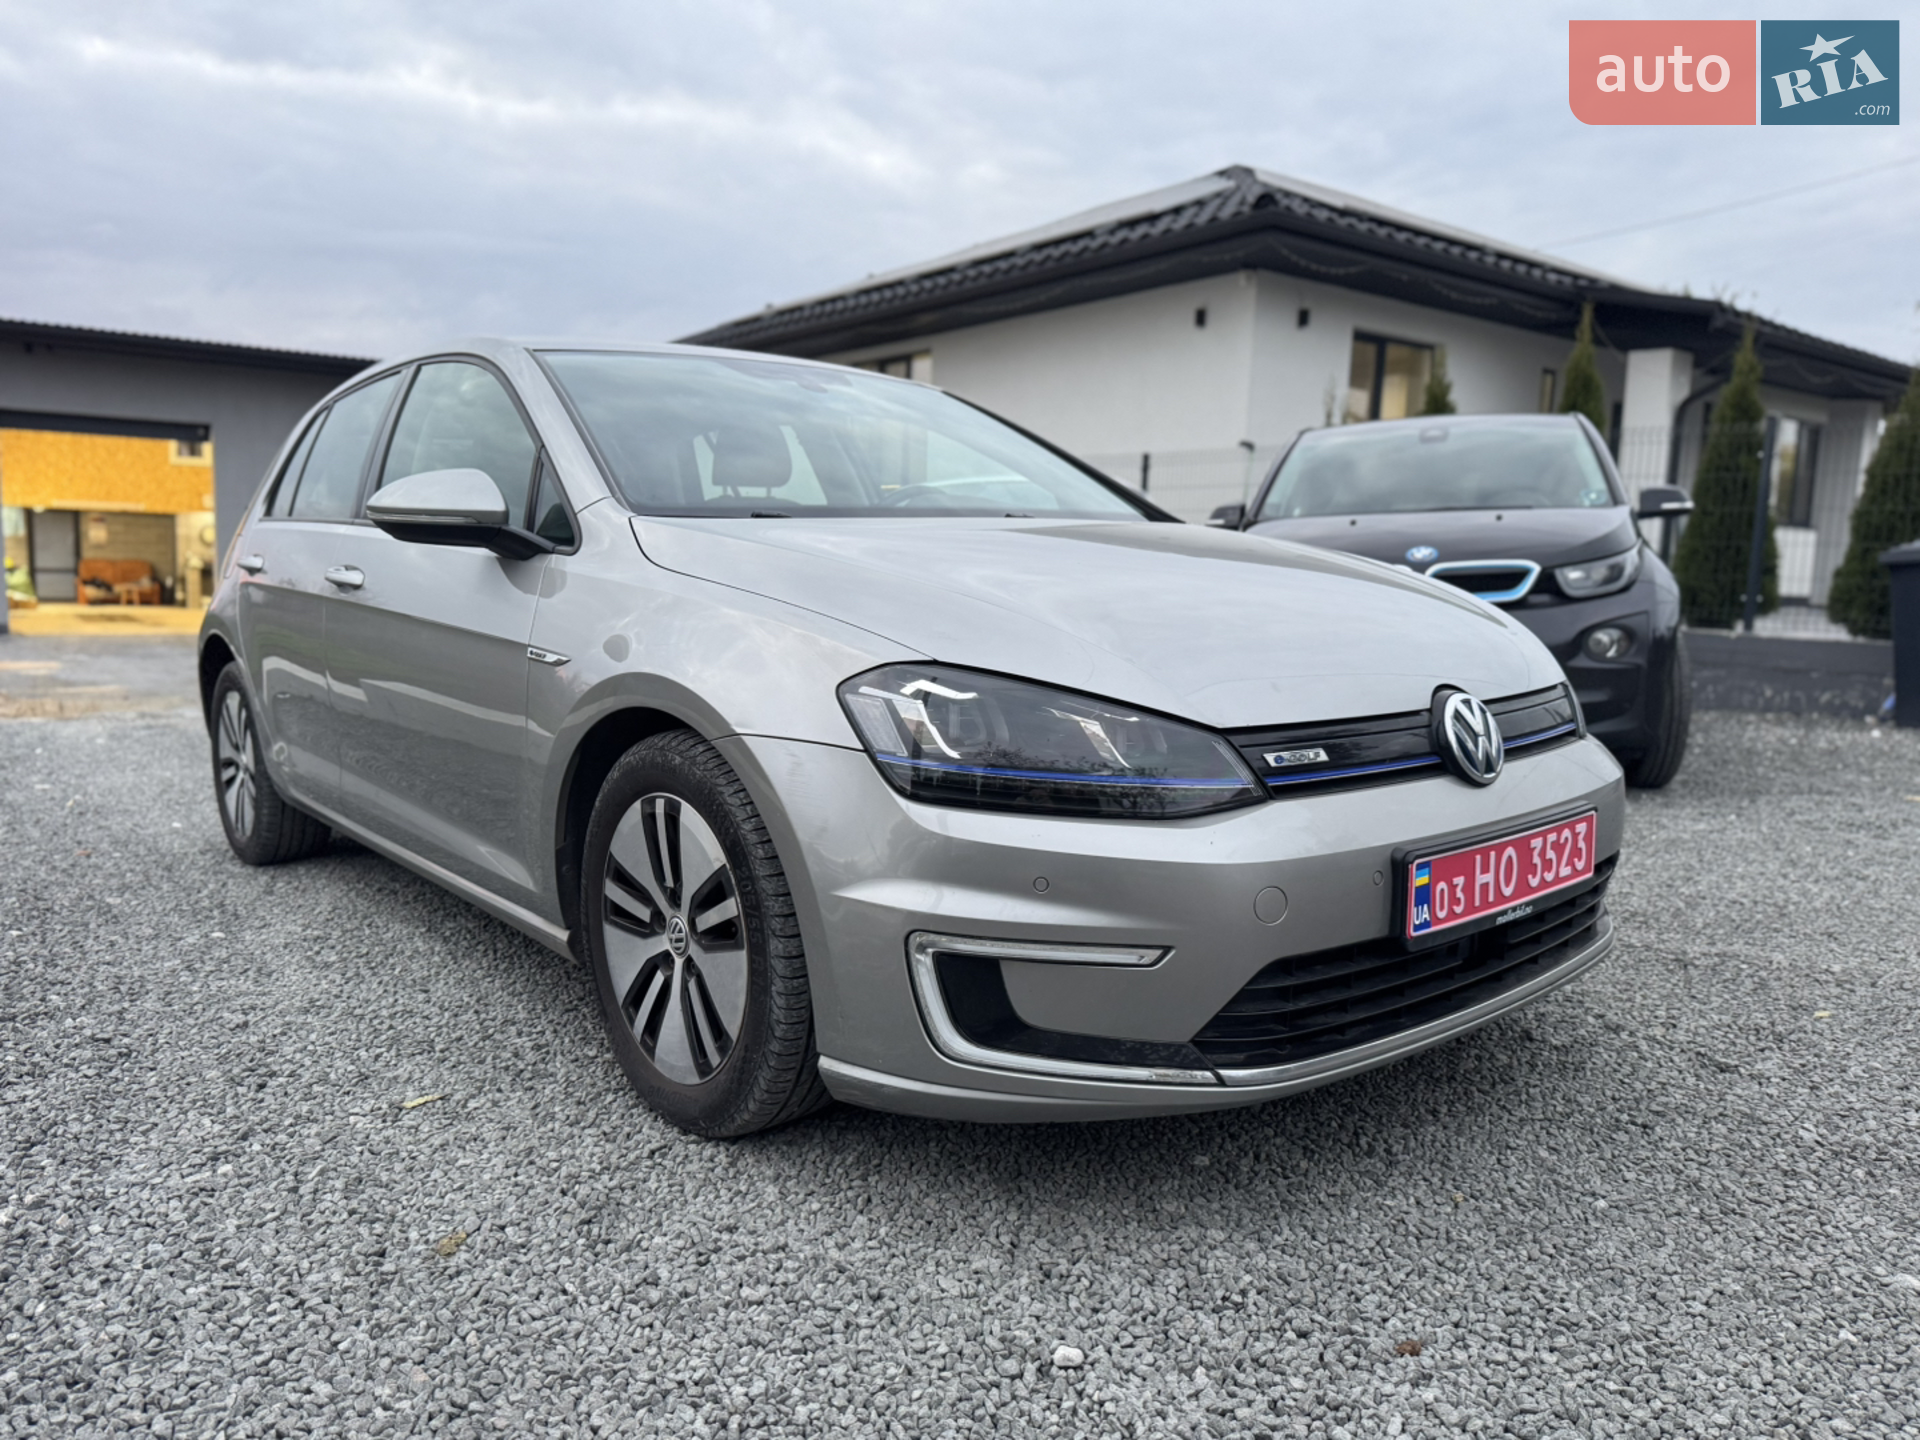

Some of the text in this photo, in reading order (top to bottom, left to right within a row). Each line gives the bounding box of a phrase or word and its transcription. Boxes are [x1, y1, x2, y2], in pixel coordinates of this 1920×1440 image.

[1435, 822, 1588, 920] 03 HO 3523
[1413, 903, 1431, 925] UA
